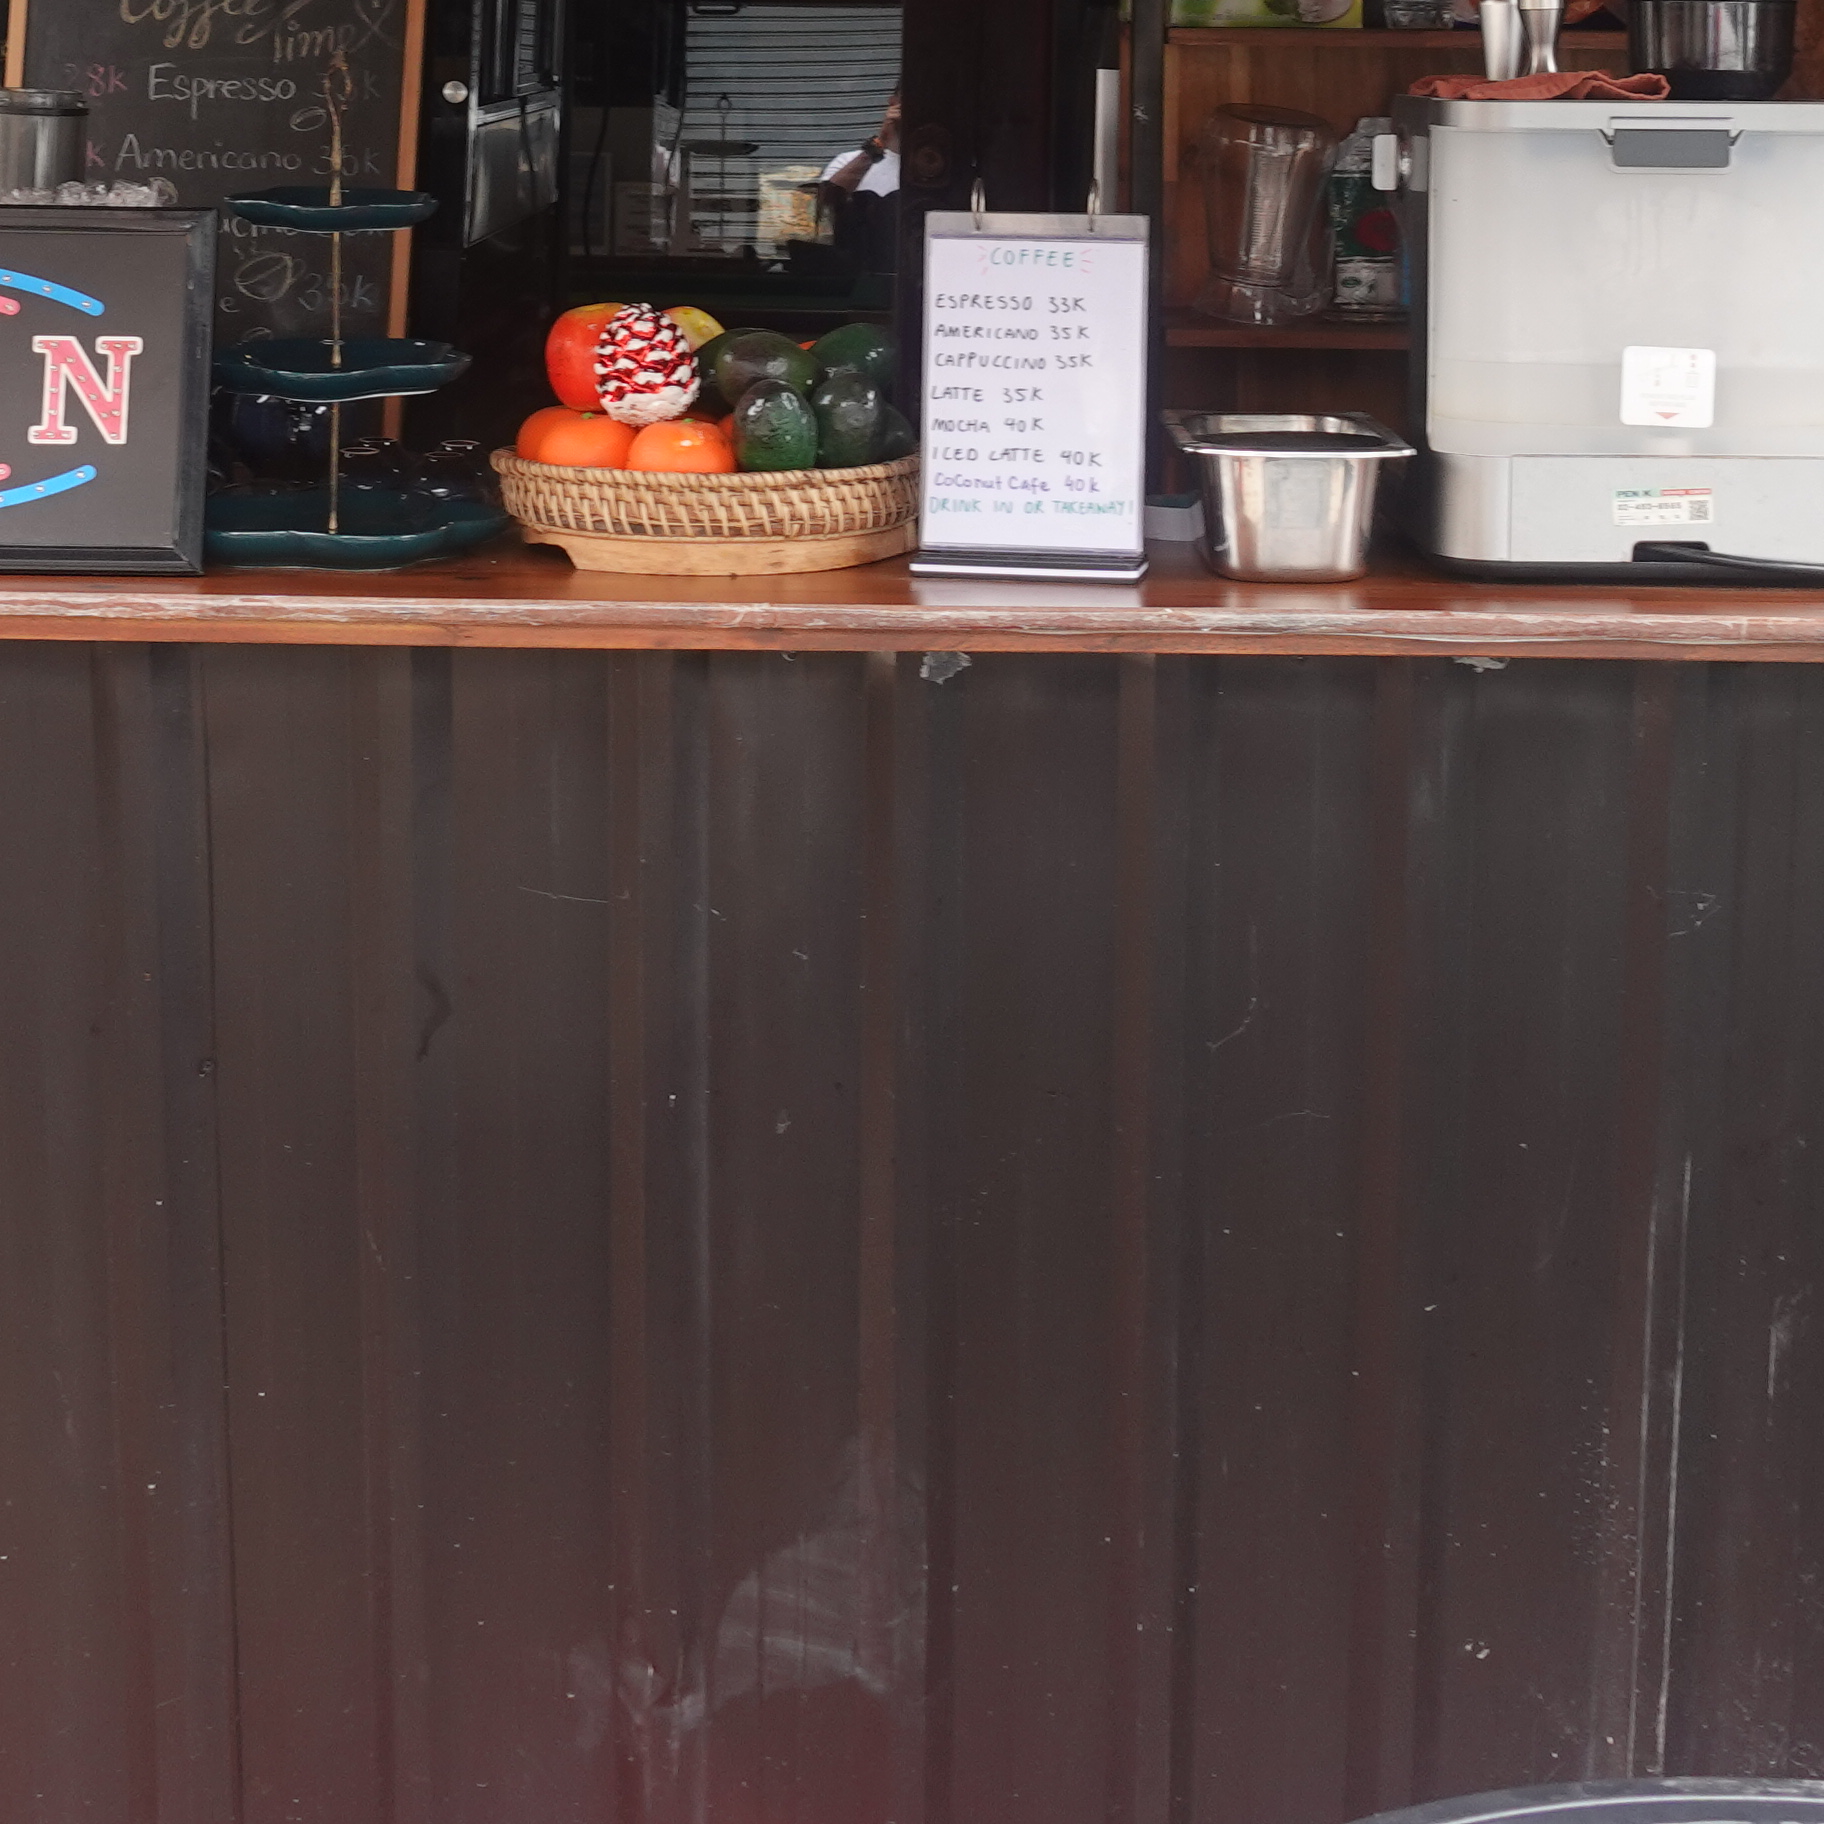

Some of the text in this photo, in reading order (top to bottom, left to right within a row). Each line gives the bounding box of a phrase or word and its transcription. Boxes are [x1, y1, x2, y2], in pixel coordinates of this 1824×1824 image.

[147, 61, 297, 120] Espresso
[114, 132, 302, 173] Americano
[989, 247, 1075, 268] COFFEE
[935, 293, 1033, 311] ESPRESSO
[934, 323, 1039, 341] AMERICANO
[934, 351, 1047, 370] CAPPUCCINO
[930, 385, 984, 403] LATTE
[931, 418, 991, 433] MOCHA
[932, 446, 979, 461] ICED
[988, 447, 1045, 463] LATTE
[1007, 475, 1051, 495] Cafe
[929, 496, 982, 514] DRINK
[993, 500, 1014, 514] IN
[1025, 499, 1045, 514] OR
